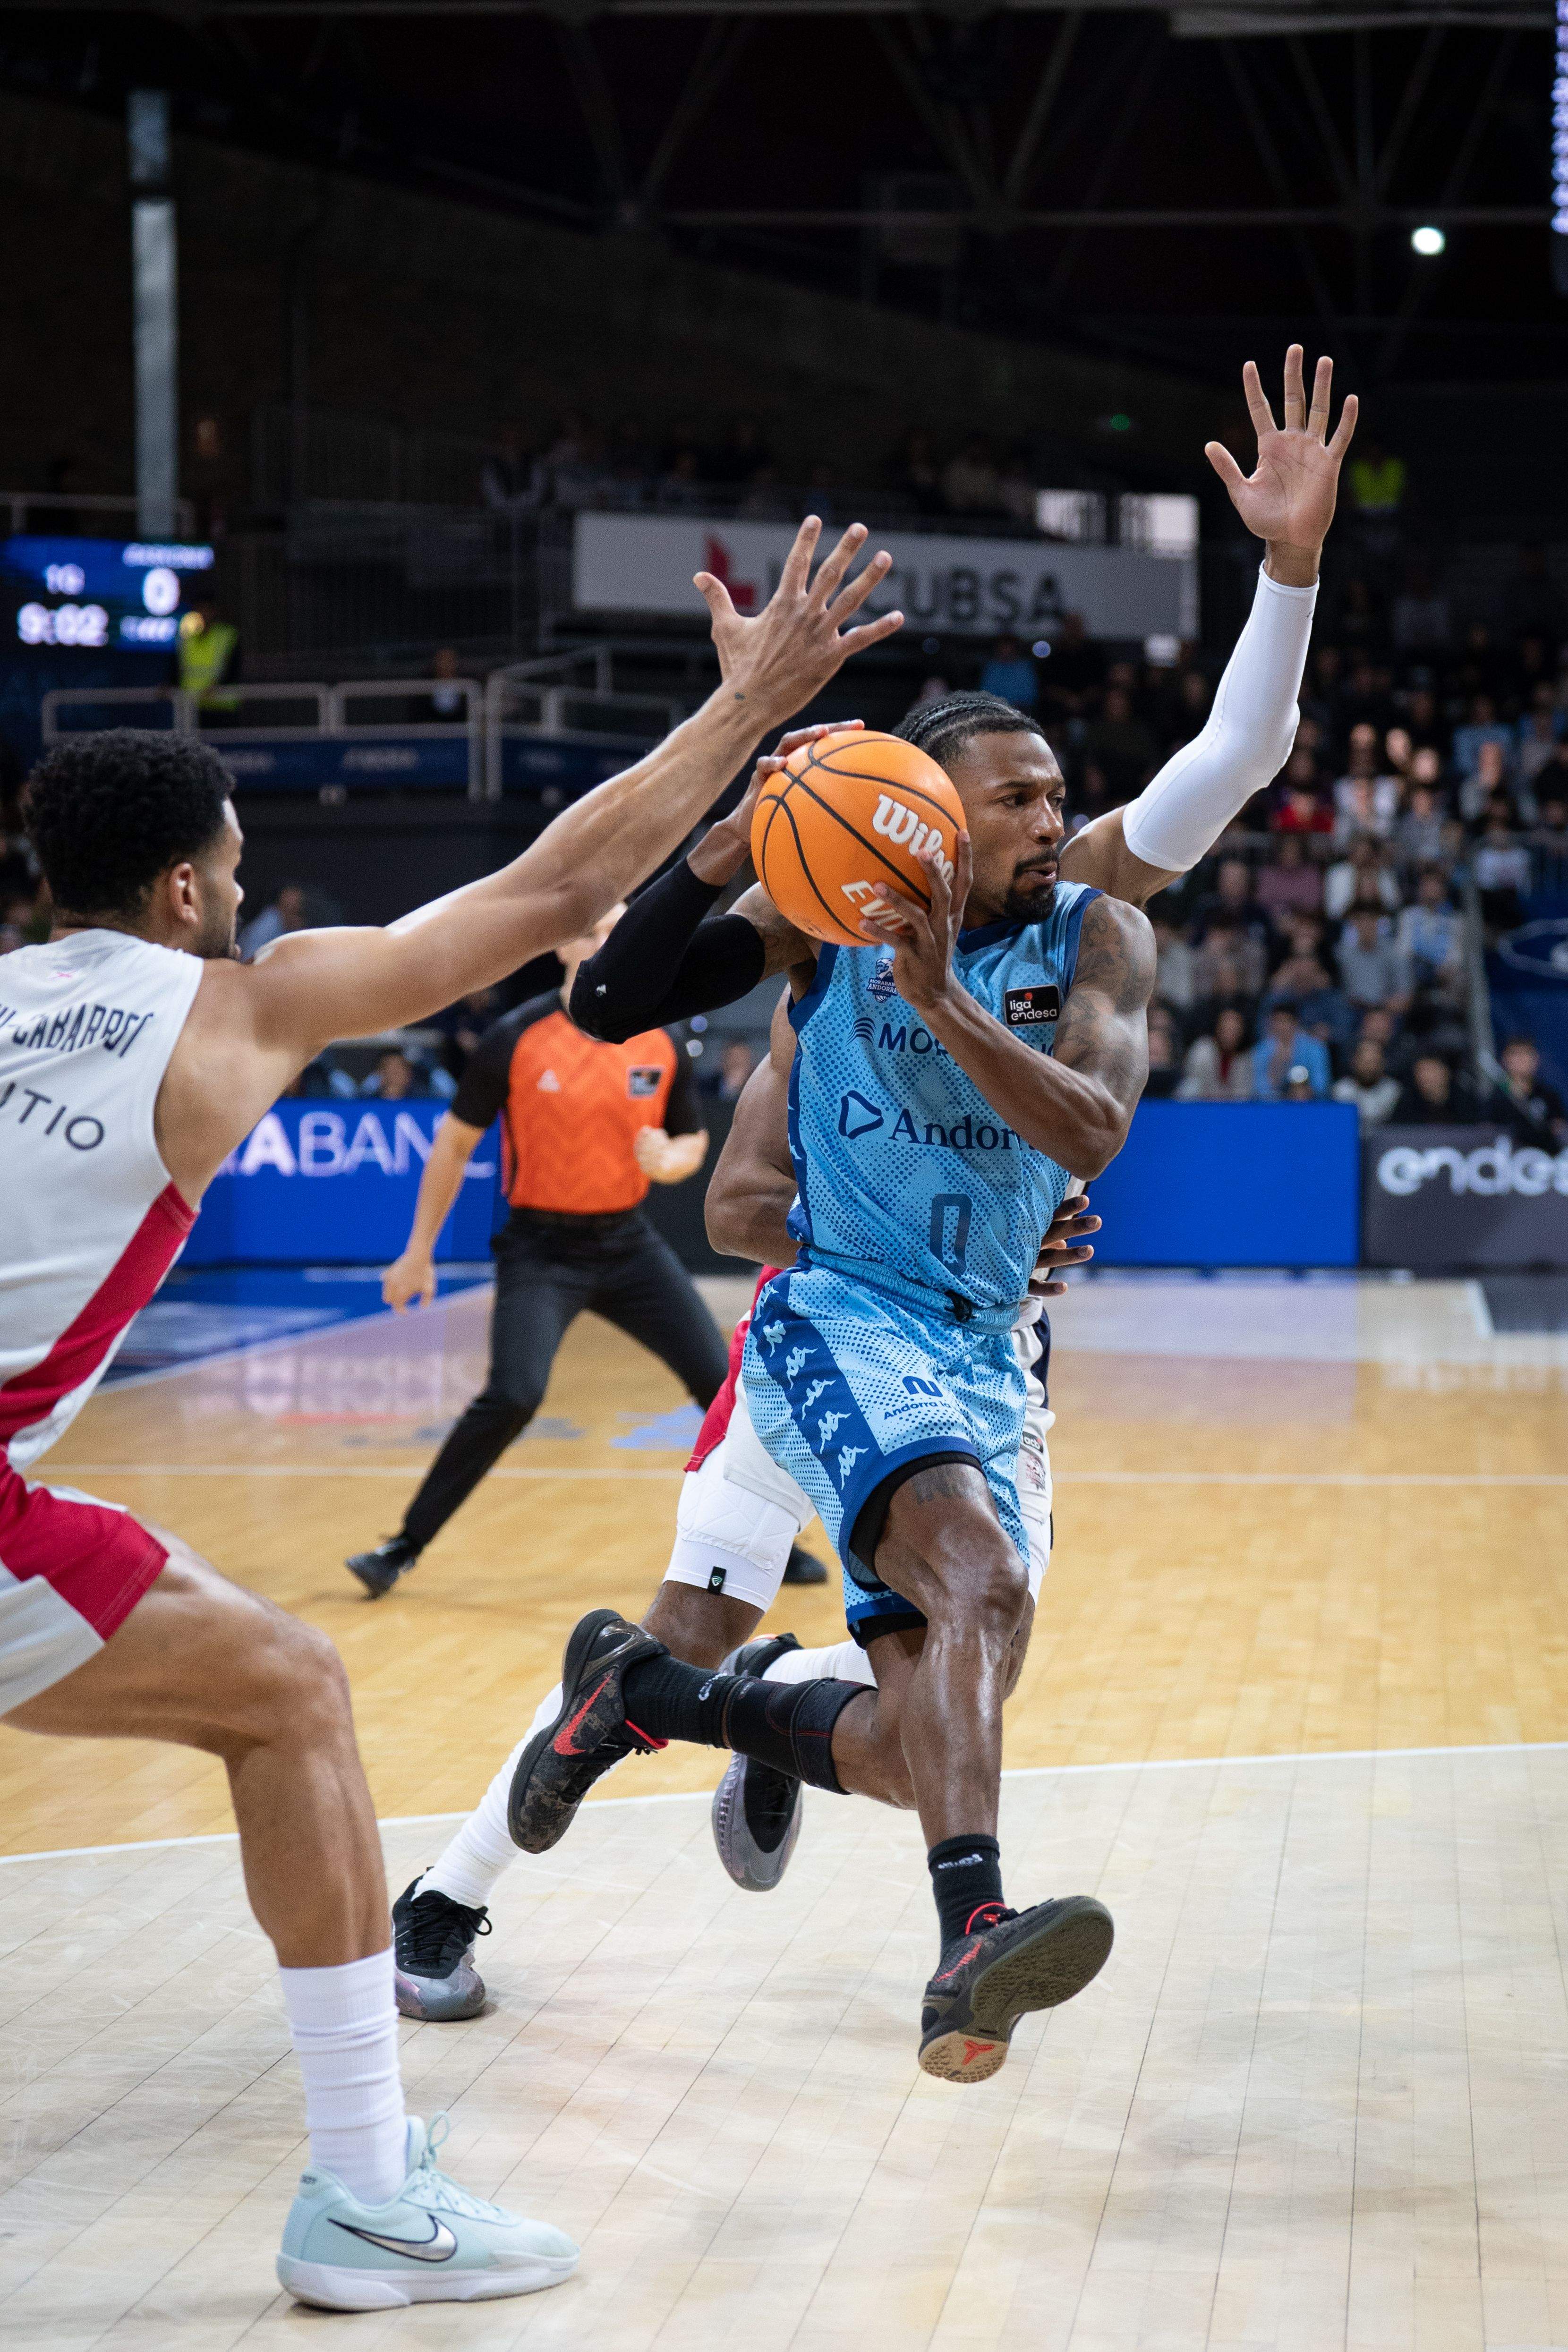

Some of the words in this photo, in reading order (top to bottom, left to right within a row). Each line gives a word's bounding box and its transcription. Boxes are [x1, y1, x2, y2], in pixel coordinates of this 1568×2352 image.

[867, 983, 897, 995] ANDORRA
[869, 979, 896, 987] MORABAN
[1010, 1000, 1031, 1011] liga
[1011, 1009, 1057, 1021] endesa
[930, 1193, 972, 1276] 0
[884, 1402, 938, 1420] Andorra
